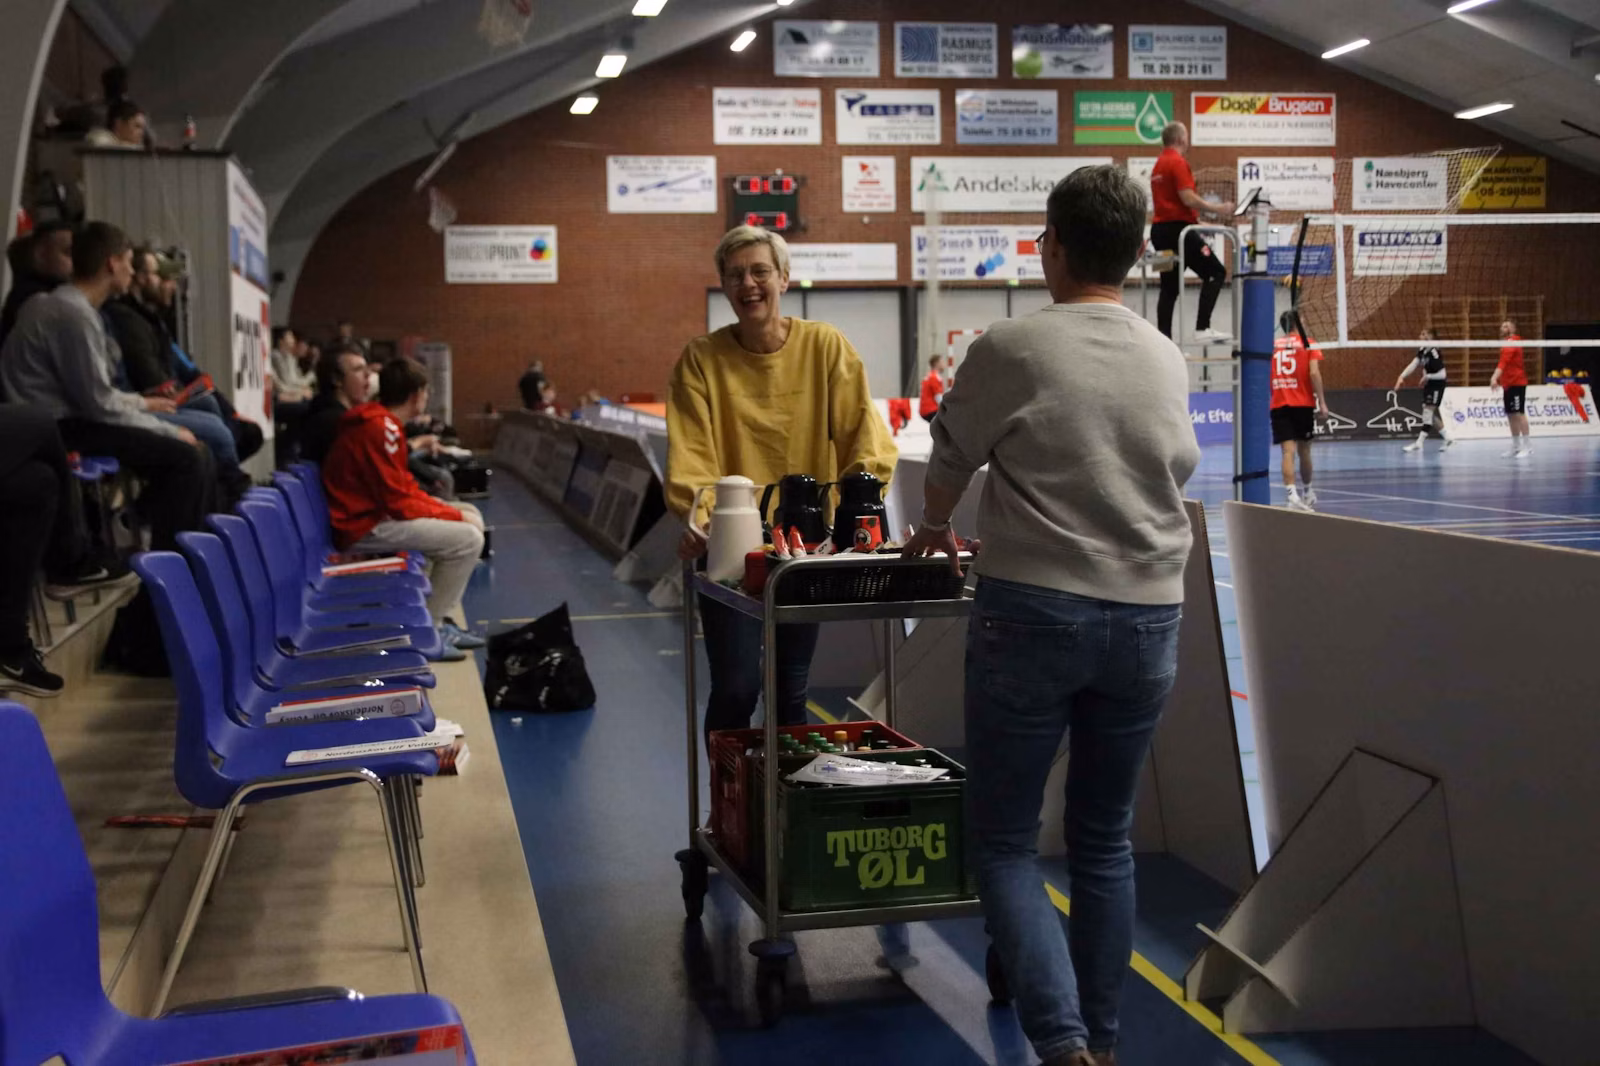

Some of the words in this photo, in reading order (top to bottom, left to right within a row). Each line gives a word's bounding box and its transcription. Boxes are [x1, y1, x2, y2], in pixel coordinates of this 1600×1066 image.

[941, 37, 993, 50] RASMUS
[1268, 96, 1325, 115] Brugsen
[1375, 168, 1428, 179] Næsbjerg
[953, 175, 1056, 194] Andelska
[1375, 179, 1438, 189] Havecenter
[1273, 349, 1297, 376] 15
[1208, 407, 1234, 424] Efte
[1466, 404, 1507, 420] AGERB
[1527, 403, 1595, 418] EL-SERVE
[325, 746, 386, 757] Nordenskov
[408, 741, 440, 749] Volley
[826, 823, 947, 868] TUBORG
[857, 849, 925, 890] ØL
